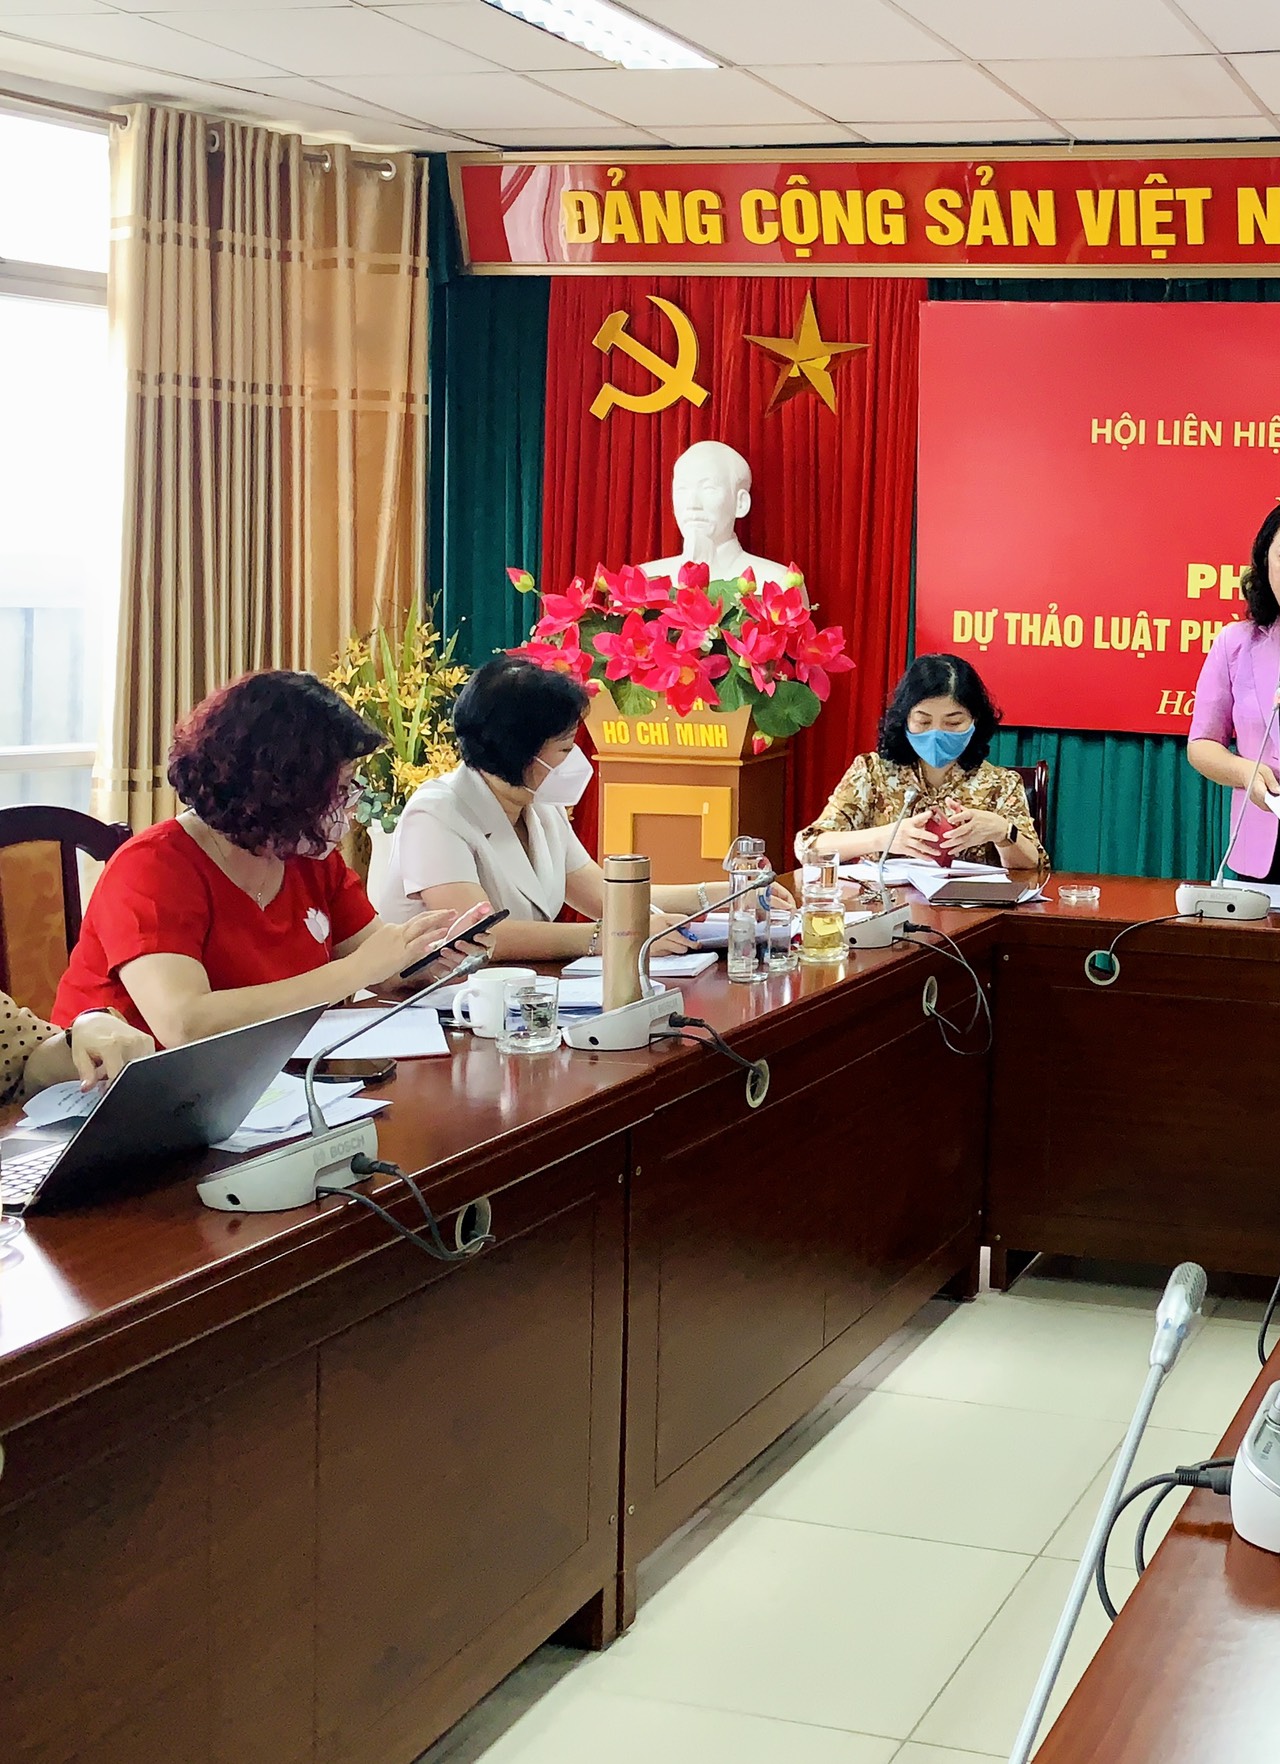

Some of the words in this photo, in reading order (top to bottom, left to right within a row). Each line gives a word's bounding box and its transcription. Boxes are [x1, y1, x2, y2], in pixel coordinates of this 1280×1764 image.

[564, 167, 722, 244] ĐẢNG
[741, 175, 905, 257] CỘNG
[925, 164, 1056, 247] SẢN
[1077, 174, 1211, 257] VIỆT
[1091, 412, 1146, 446] HỘI
[1157, 413, 1222, 447] LIÊN
[952, 608, 999, 651] DỰ
[1003, 603, 1084, 648] THẢO
[1094, 610, 1171, 659] LUẬT
[635, 716, 671, 746] CHÍ
[674, 722, 728, 748] MINH
[329, 1134, 366, 1159] BOSCH
